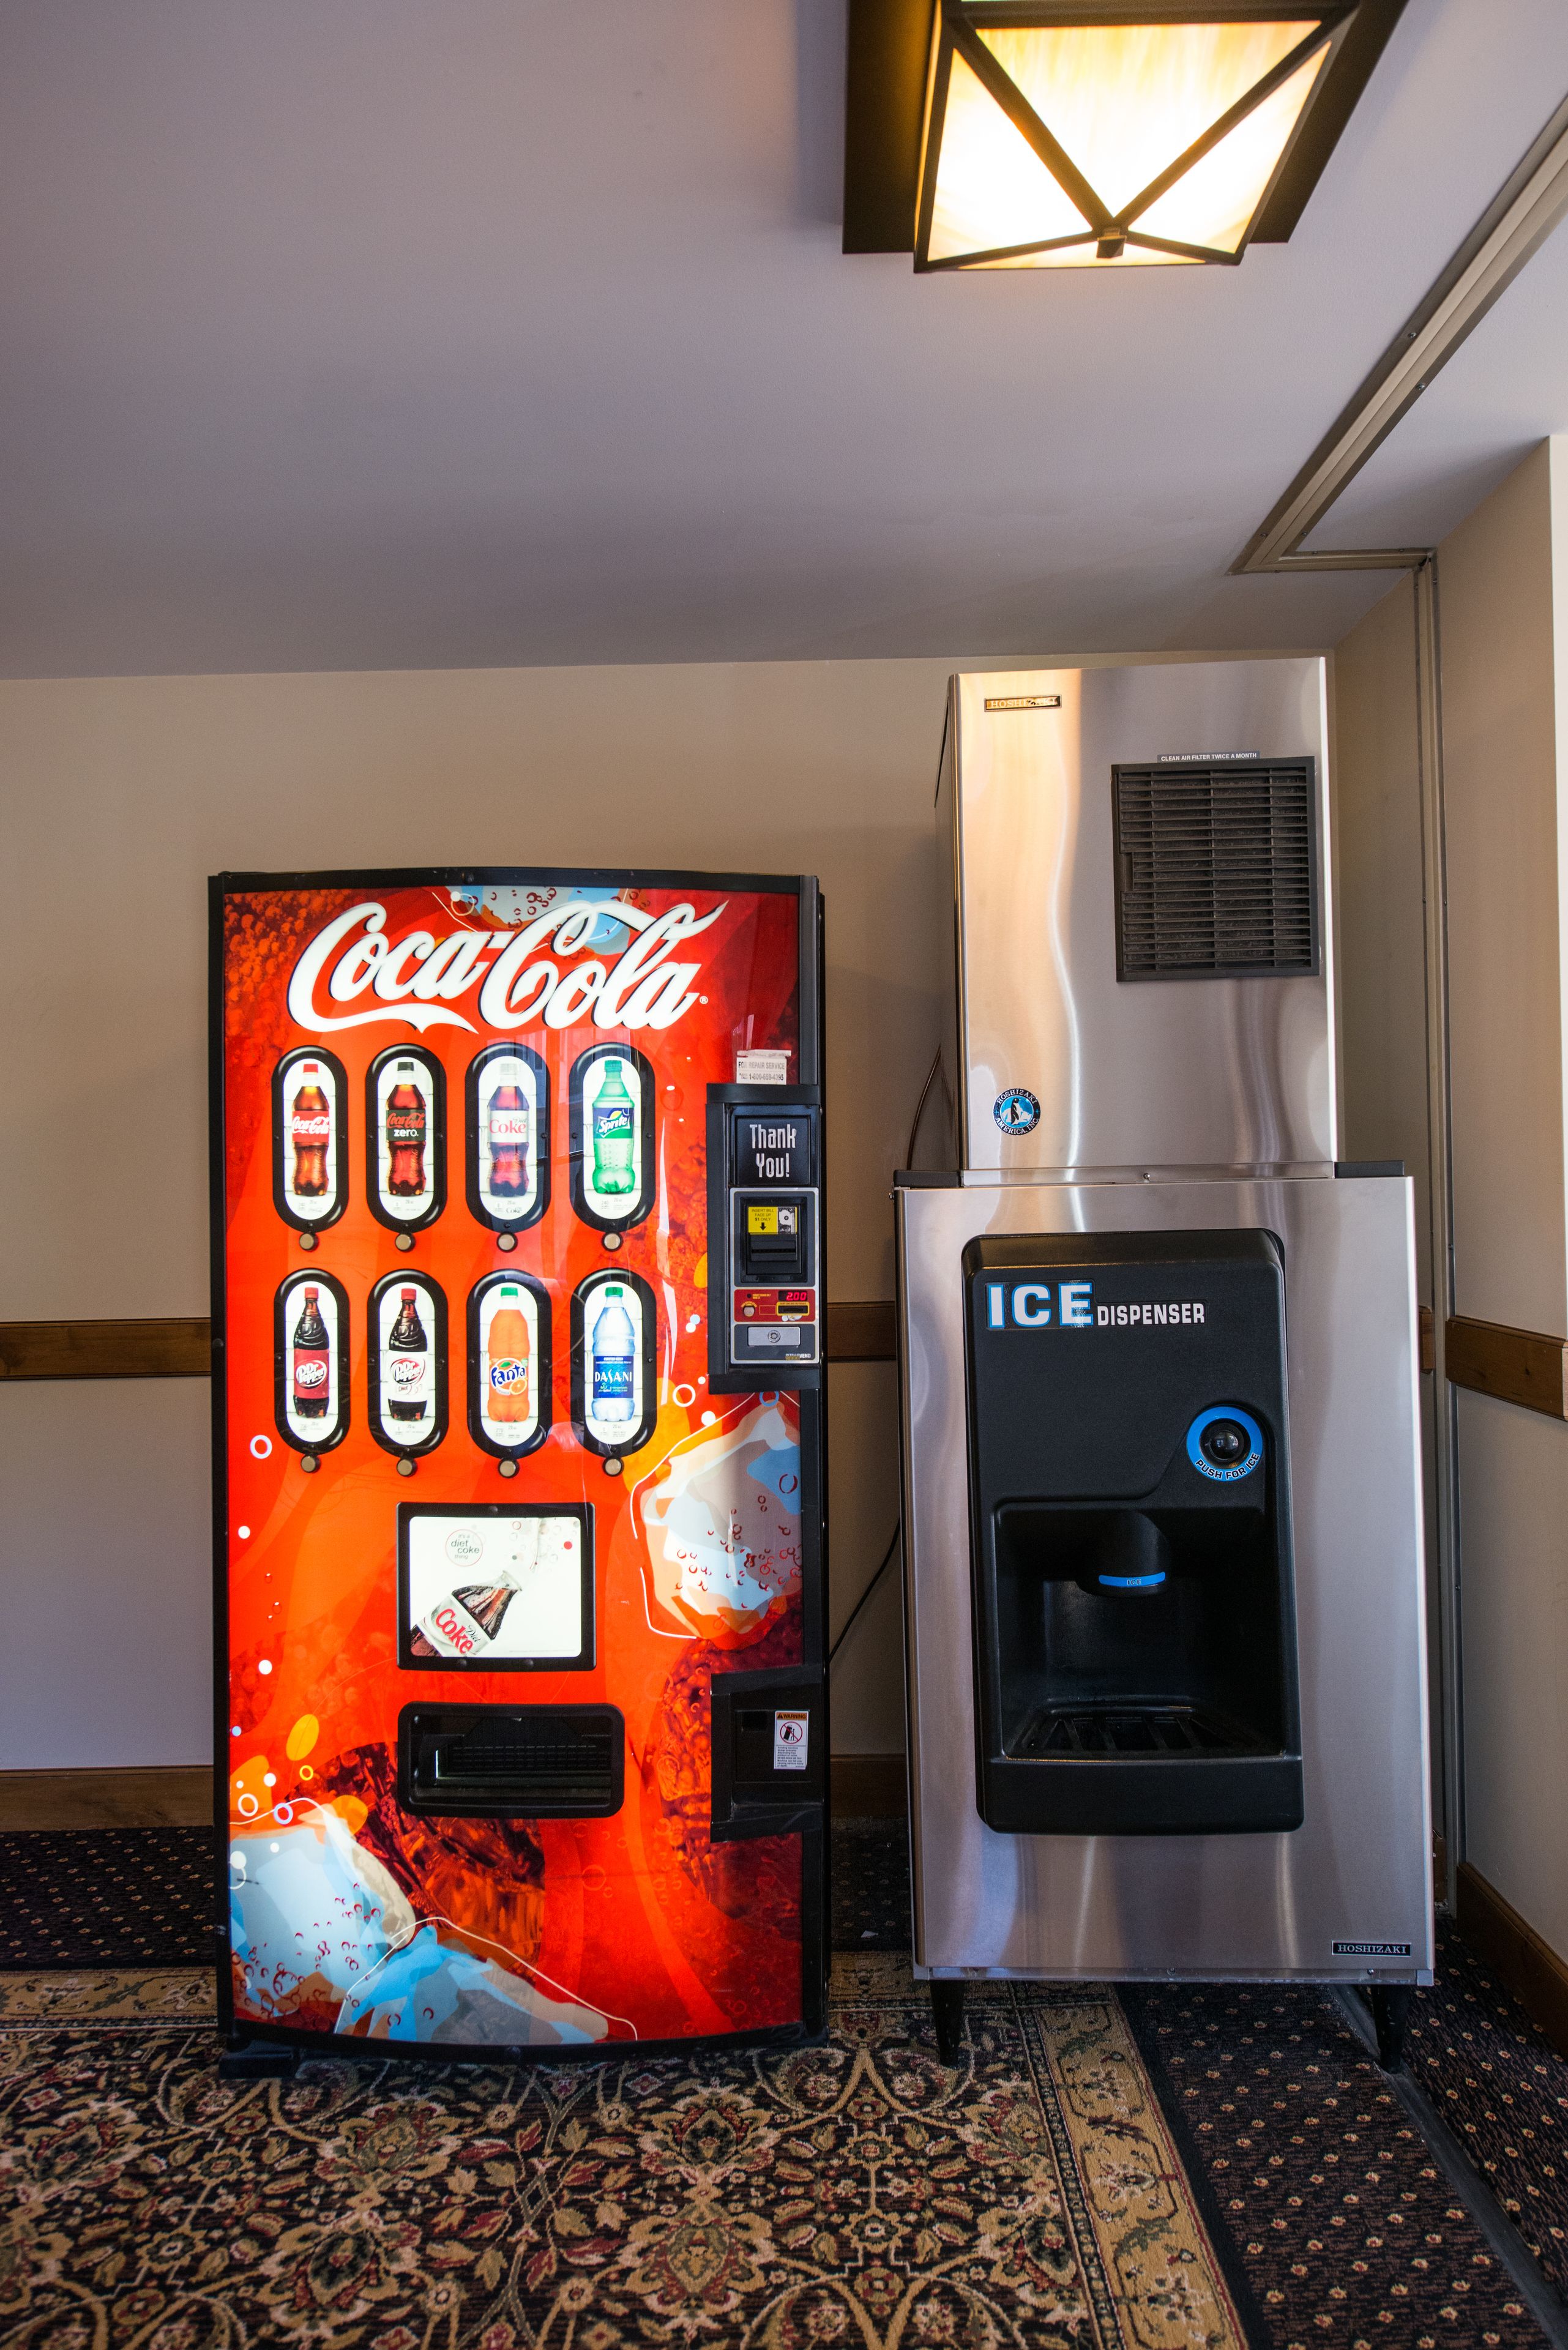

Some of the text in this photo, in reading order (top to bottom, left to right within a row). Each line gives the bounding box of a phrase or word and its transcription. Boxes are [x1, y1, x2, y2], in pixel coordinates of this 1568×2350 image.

[288, 900, 729, 1034] Coca-Cola
[996, 1089, 1038, 1105] HOSHIZAKI
[386, 1113, 425, 1129] Coca-Cola
[489, 1119, 527, 1134] Coke
[598, 1116, 628, 1134] Sprite
[749, 1124, 797, 1149] Thank
[755, 1152, 790, 1178] You!
[786, 1292, 807, 1301] 2.00
[987, 1282, 1205, 1328] ICE DISPENSER
[594, 1368, 633, 1384] DASANI
[1195, 1452, 1261, 1480] PUSH FOR ICE
[450, 1539, 468, 1547] diet
[457, 1545, 480, 1554] coke
[435, 1608, 474, 1655] Coke
[466, 1625, 481, 1642] Diet
[1337, 1944, 1406, 1954] HOSHIZAKI
